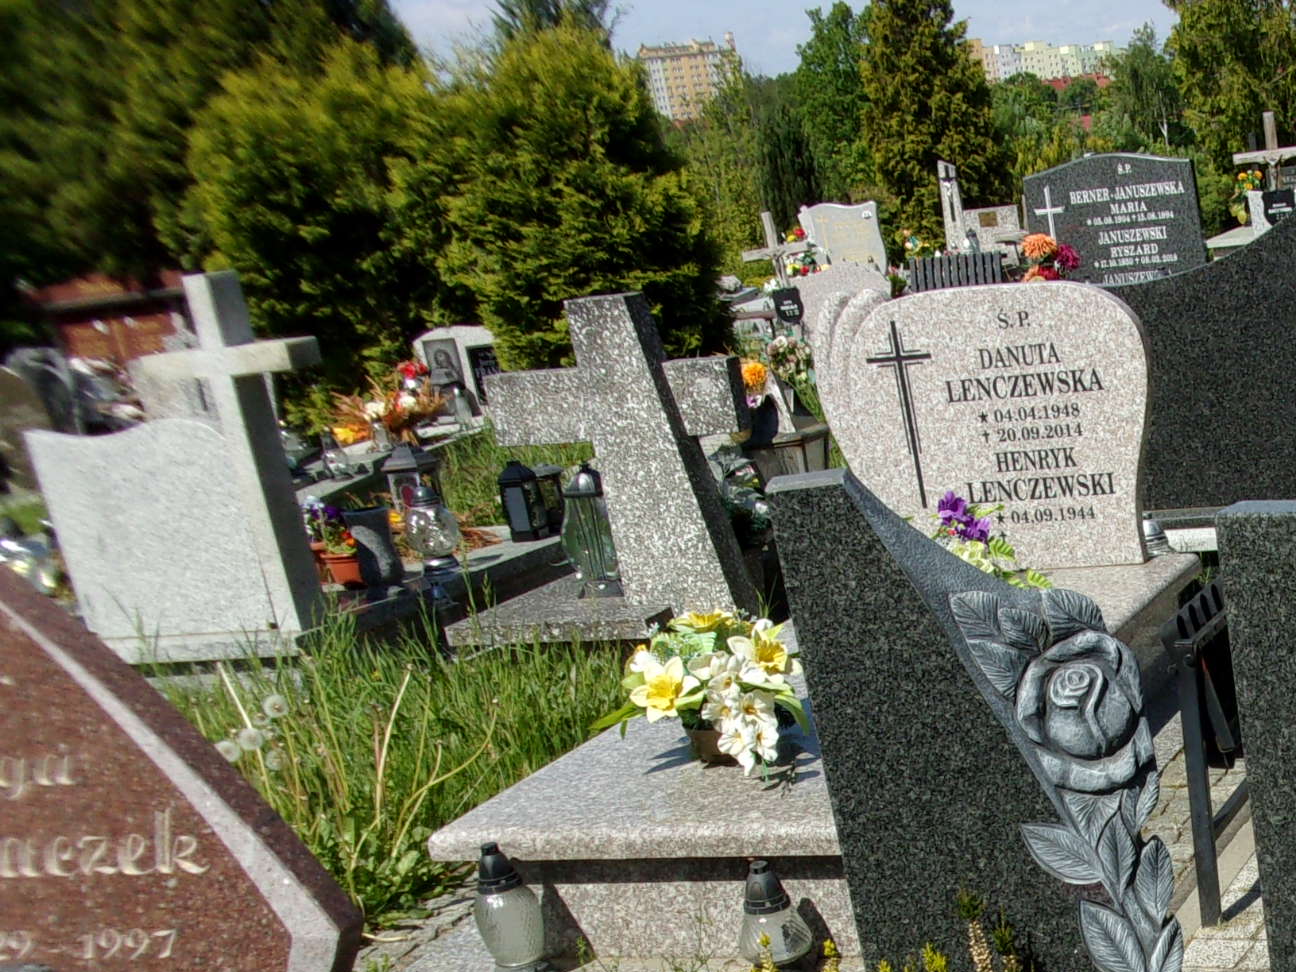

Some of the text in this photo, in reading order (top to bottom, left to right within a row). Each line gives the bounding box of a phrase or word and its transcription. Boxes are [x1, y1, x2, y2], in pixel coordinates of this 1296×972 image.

[1110, 201, 1147, 215] MARIA
[1098, 226, 1167, 245] JANUSZEWSKI
[1110, 243, 1159, 258] RYSZARD
[997, 309, 1031, 329] Ś. P.
[978, 342, 1061, 370] DANUTA
[945, 368, 1105, 403] LENCZEWSKA
[994, 403, 1081, 423] 04.04.1948
[997, 423, 1083, 443] 20.09.2014
[994, 447, 1078, 473] HENRYK
[966, 472, 1116, 504] LENCZEWSKI
[1011, 506, 1095, 524] 04.09.1944
